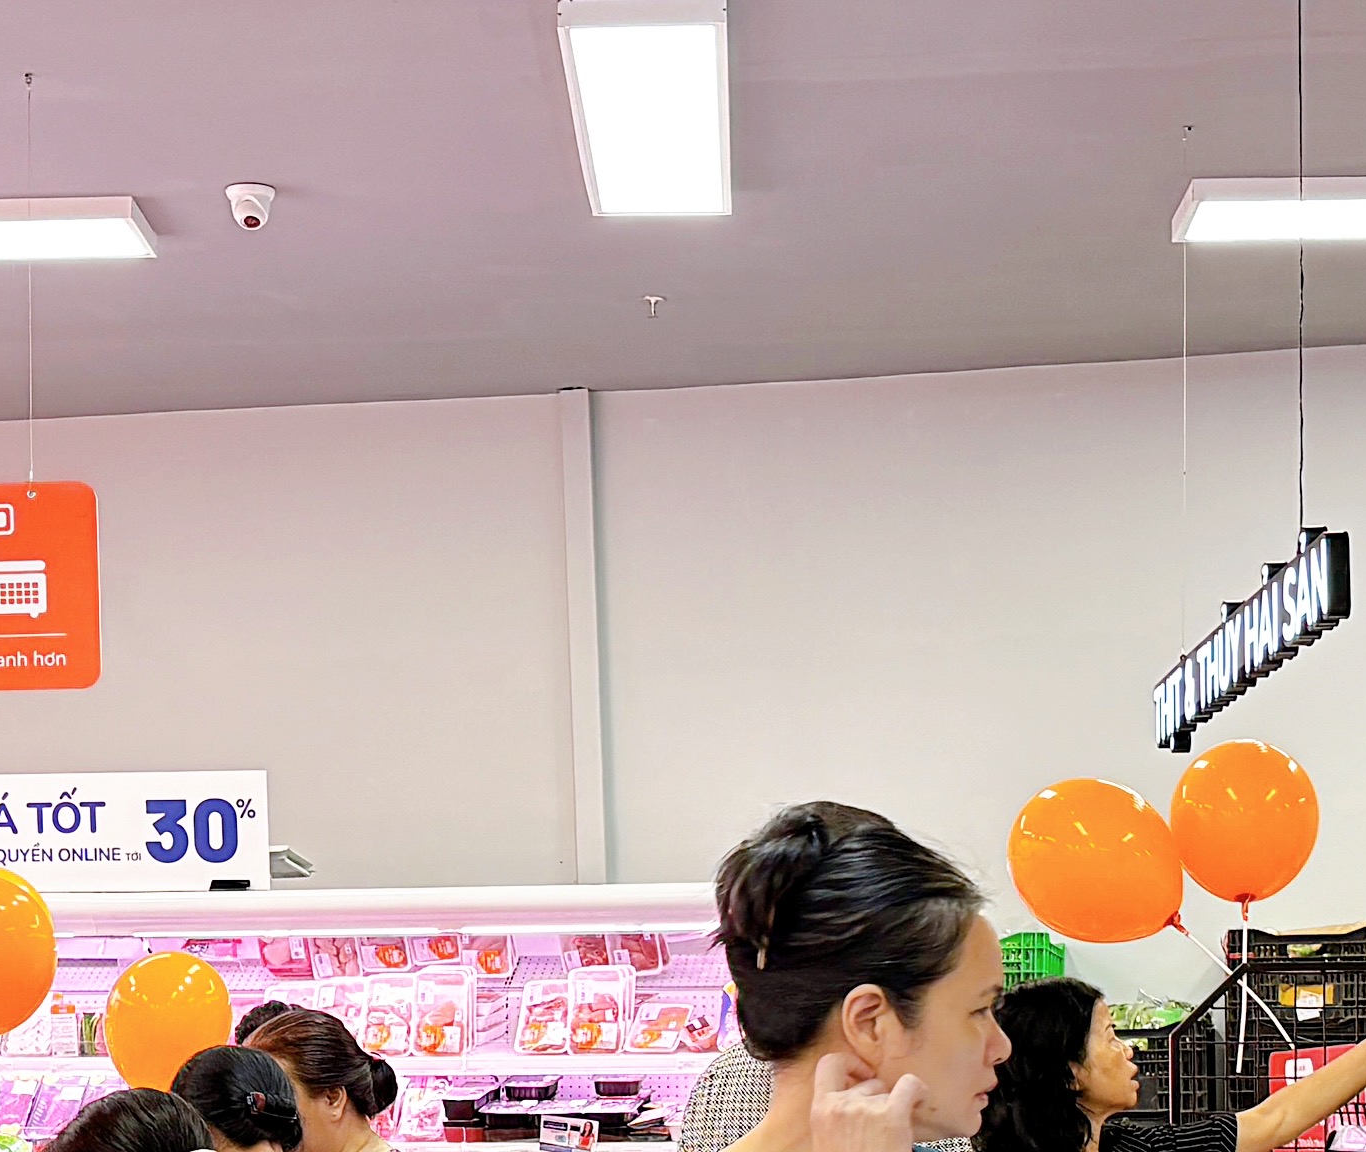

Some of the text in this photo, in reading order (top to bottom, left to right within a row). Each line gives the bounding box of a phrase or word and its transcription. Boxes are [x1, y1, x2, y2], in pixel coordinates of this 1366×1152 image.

[33, 650, 66, 667] hơn
[1153, 667, 1182, 751] THỊT
[1244, 565, 1278, 678] HẢI
[1282, 531, 1328, 641] SẢN
[27, 787, 106, 834] TỐT
[145, 797, 256, 864] 30%
[58, 847, 121, 863] ONLINE
